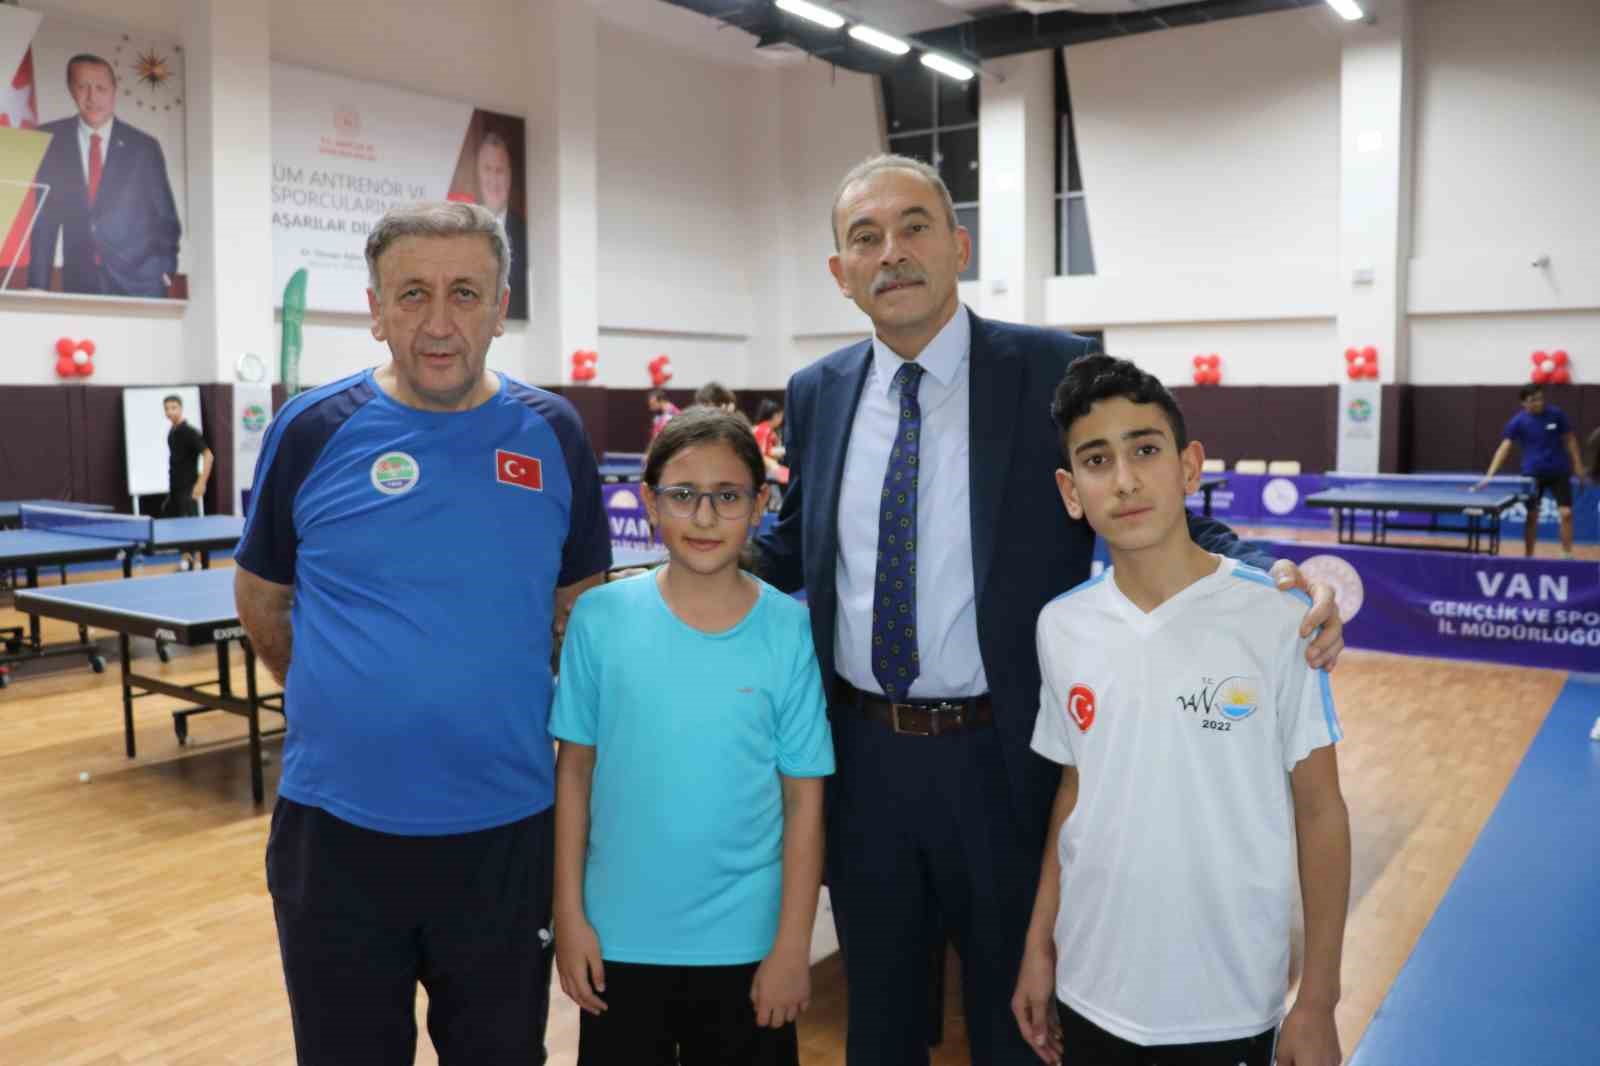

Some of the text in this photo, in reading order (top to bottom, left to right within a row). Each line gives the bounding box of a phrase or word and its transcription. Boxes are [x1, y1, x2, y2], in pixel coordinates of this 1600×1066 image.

[309, 169, 401, 197] ANTRENÖR
[1476, 571, 1568, 603] VAN
[1429, 600, 1519, 622] GENÇLİK
[1522, 606, 1550, 623] VE
[1201, 719, 1232, 731] 2022
